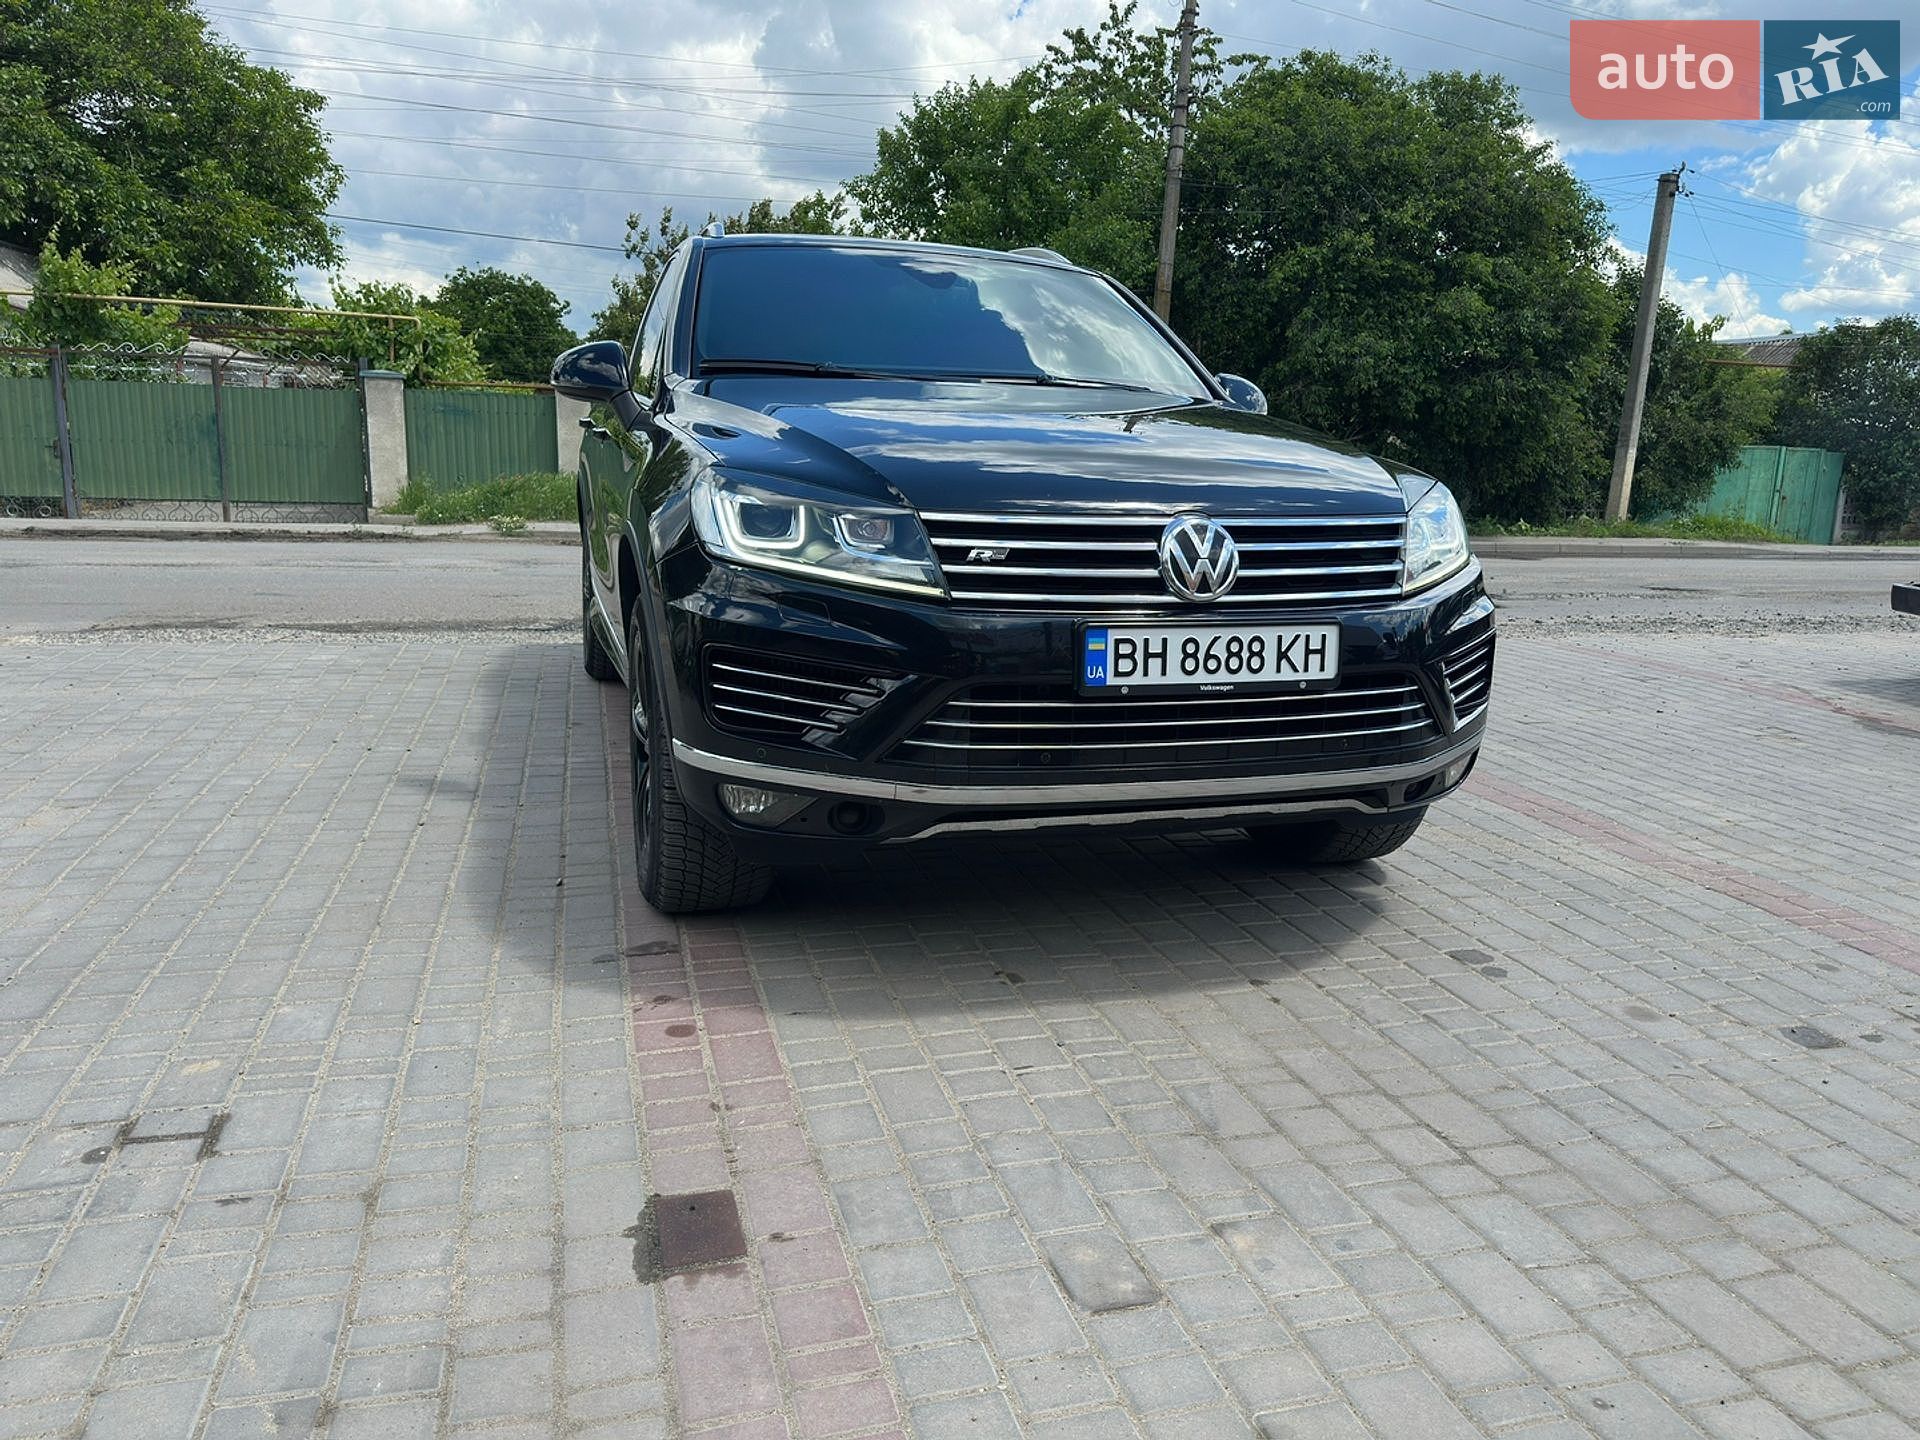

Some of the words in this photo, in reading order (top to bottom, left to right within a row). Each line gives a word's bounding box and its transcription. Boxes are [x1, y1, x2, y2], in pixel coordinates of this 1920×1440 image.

[1113, 637, 1168, 678] BH
[1180, 635, 1266, 676] 8688
[1275, 633, 1327, 674] KH
[1087, 665, 1105, 679] UA
[1199, 684, 1234, 692] Volkswagen
